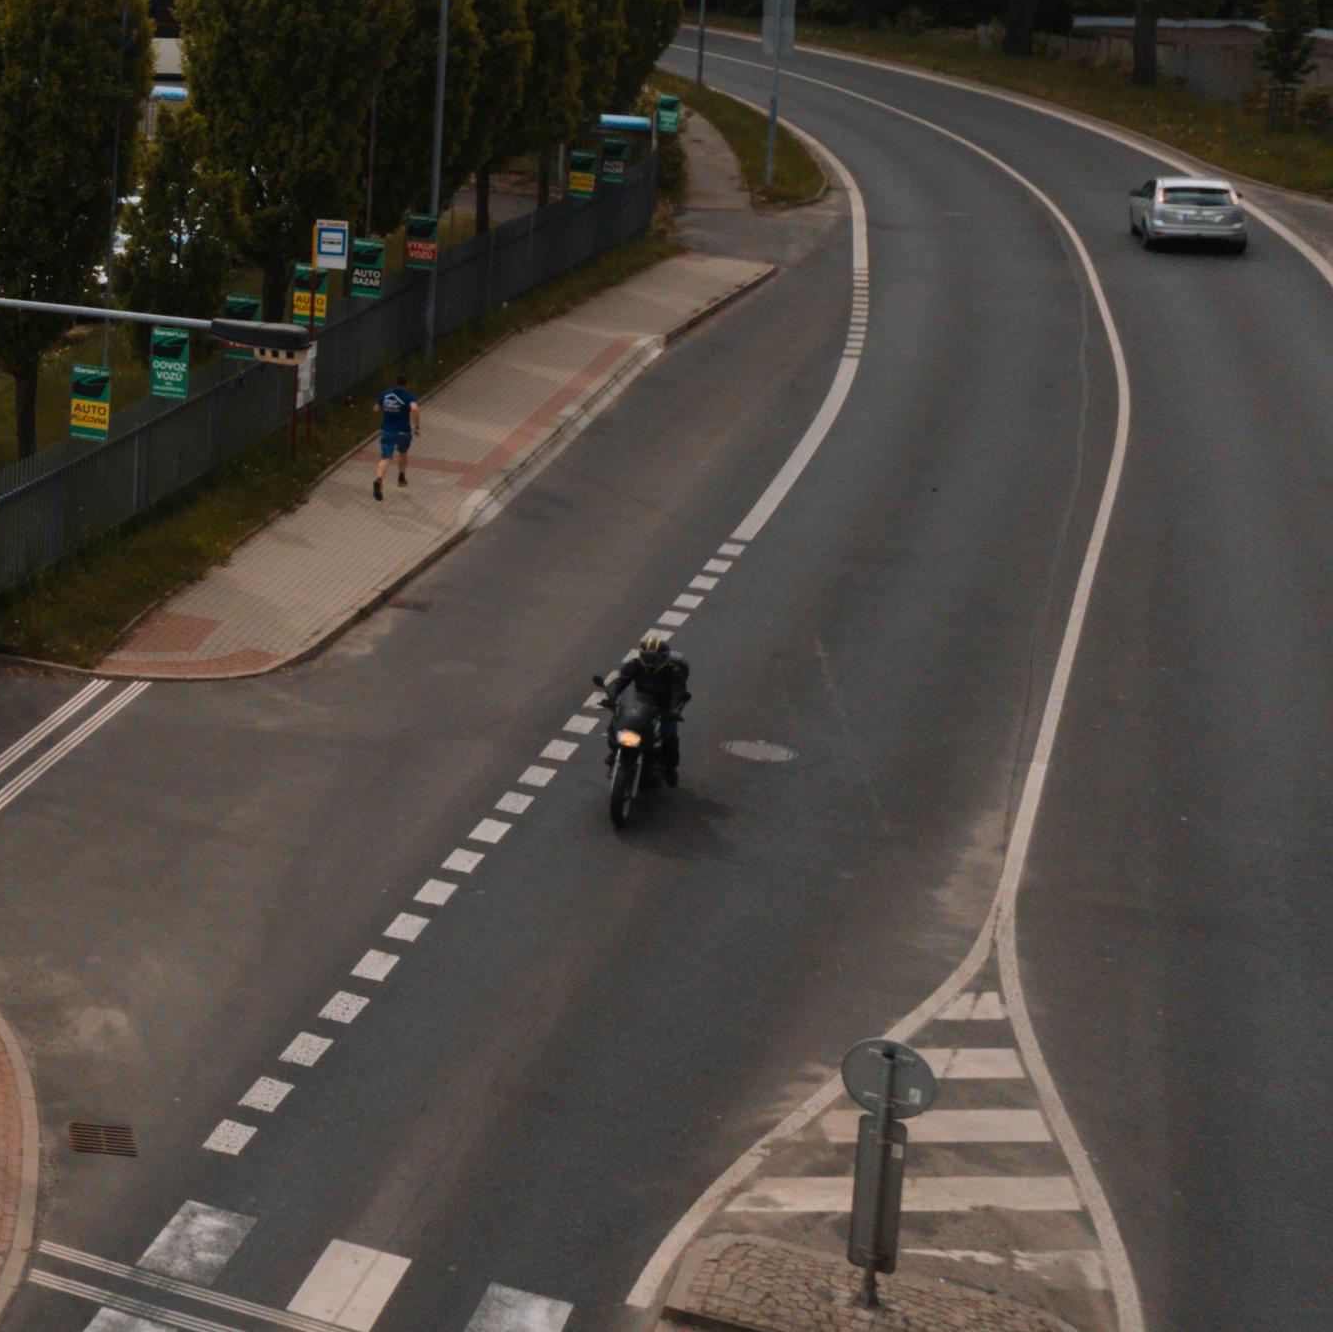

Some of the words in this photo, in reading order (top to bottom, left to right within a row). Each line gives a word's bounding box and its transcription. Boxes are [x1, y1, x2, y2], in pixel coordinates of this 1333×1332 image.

[353, 268, 381, 279] AUTO
[352, 276, 381, 287] BAZAR
[153, 360, 187, 372] DOVOZ
[73, 403, 107, 416] AUTO
